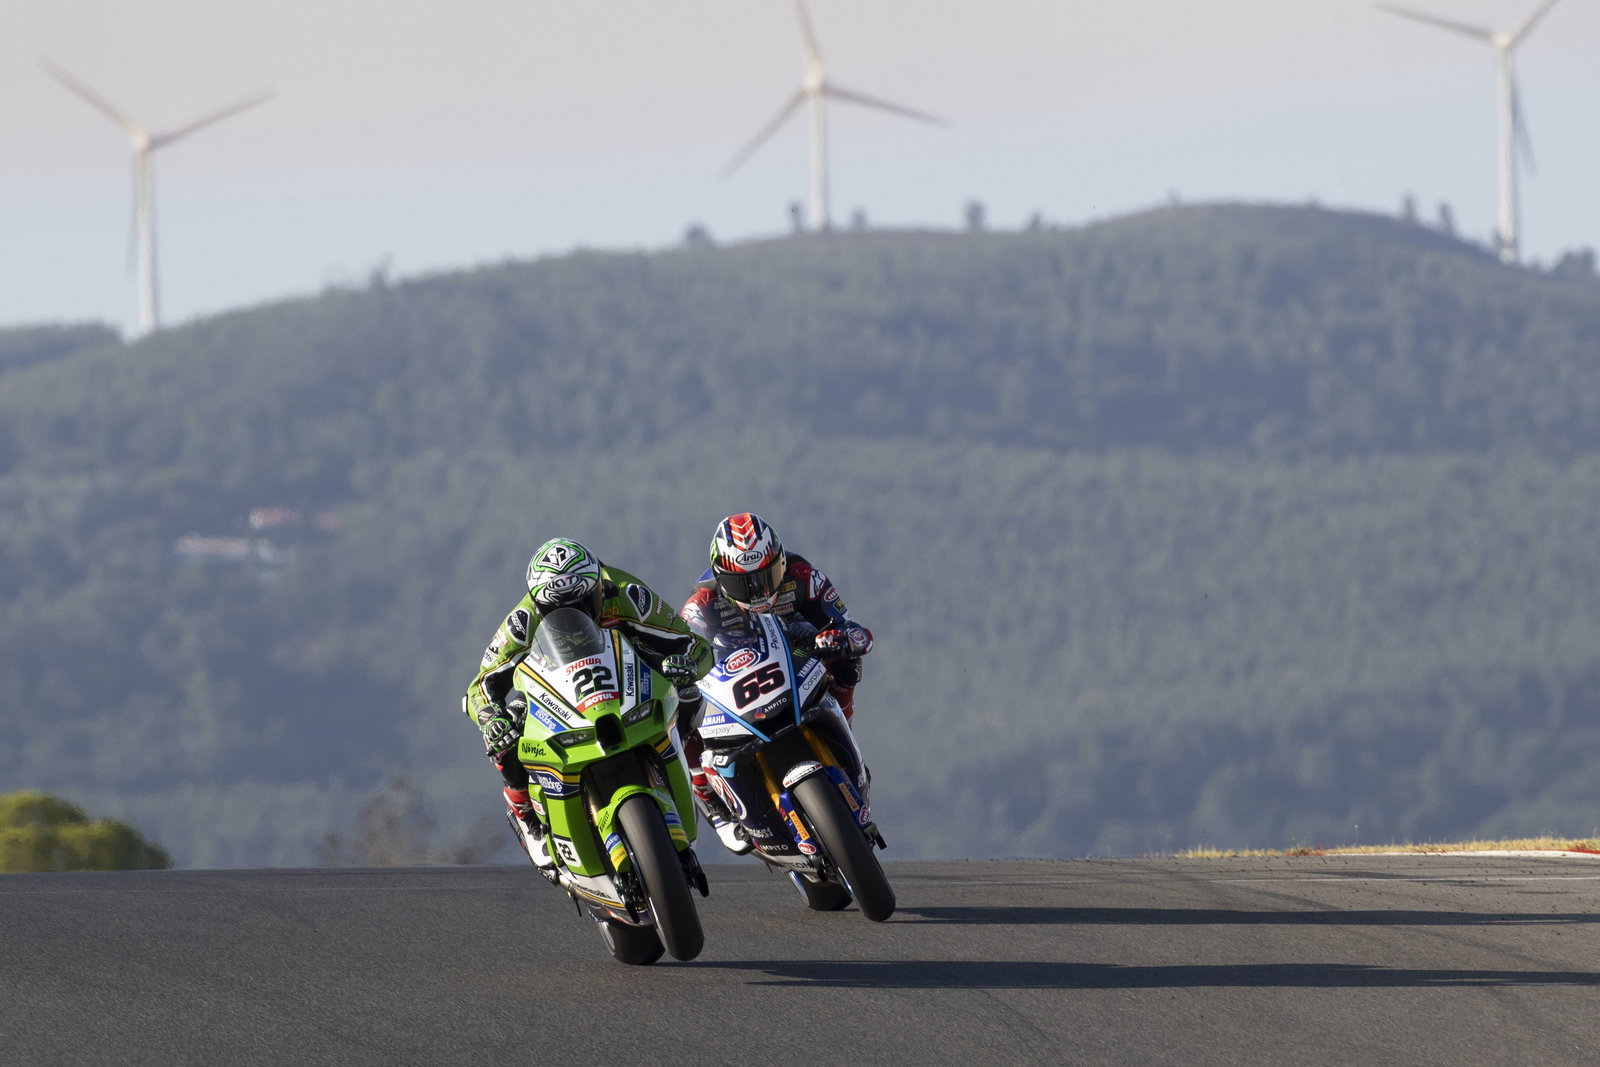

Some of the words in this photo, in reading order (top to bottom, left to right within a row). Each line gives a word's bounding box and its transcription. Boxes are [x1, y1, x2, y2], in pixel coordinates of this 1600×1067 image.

[740, 553, 760, 562] Arai
[565, 658, 602, 676] SHOWA
[729, 653, 752, 669] PATA
[797, 657, 818, 679] YAMAHA
[572, 666, 615, 703] 22
[625, 662, 634, 697] Kawasaki
[732, 662, 786, 710] 65
[538, 692, 573, 721] Kawasaki
[584, 693, 615, 709] MOTUL
[764, 697, 788, 714] AMPITO
[702, 715, 725, 726] AMAHA
[702, 727, 731, 737] Corpay
[521, 742, 547, 758] Ninja
